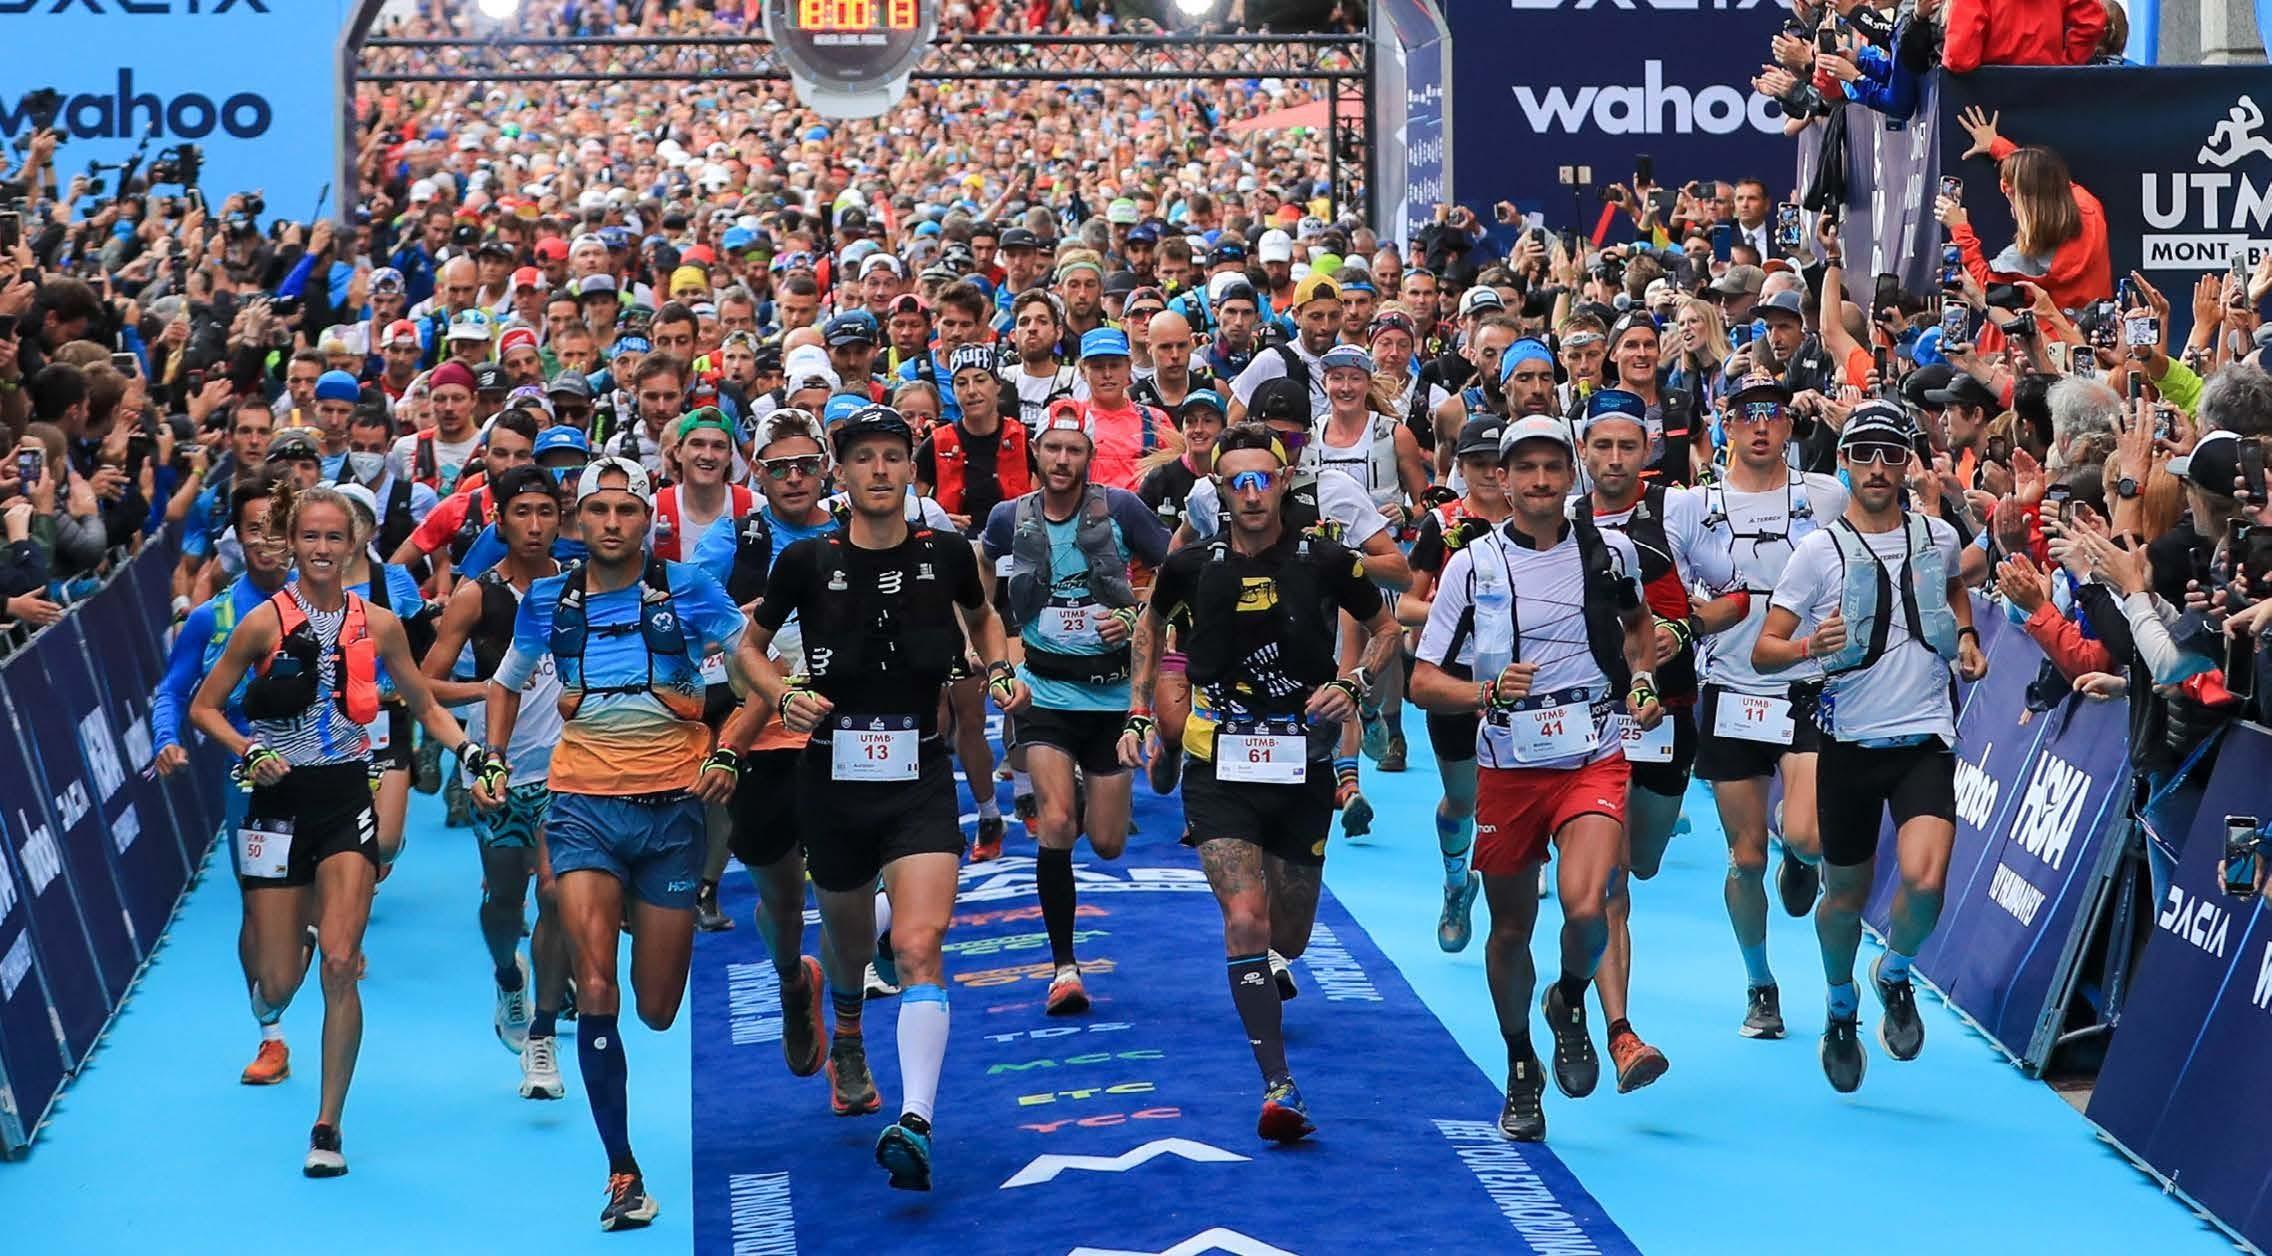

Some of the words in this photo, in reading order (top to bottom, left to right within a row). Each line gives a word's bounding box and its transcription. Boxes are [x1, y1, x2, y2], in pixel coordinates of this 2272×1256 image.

[1059, 610, 1085, 619] UTMB
[1063, 619, 1085, 631] 23
[1742, 697, 1769, 709] UTMB
[1534, 710, 1565, 722] UTMB
[1745, 708, 1764, 722] 11
[1540, 720, 1564, 737] 41
[1621, 727, 1642, 741] 25
[860, 734, 892, 743] UTMB
[1245, 738, 1276, 747] UTMB
[865, 744, 889, 760] 13
[1248, 748, 1271, 763] 61
[2010, 749, 2092, 871] HOKA
[248, 843, 262, 858] 50
[2158, 885, 2231, 958] DACIA
[984, 1022, 1133, 1043] TDS
[986, 1050, 1165, 1075] MCC
[1018, 1082, 1155, 1106] ETC
[1016, 1107, 1182, 1133] YCC
[1452, 1144, 1532, 1173] YOUR
